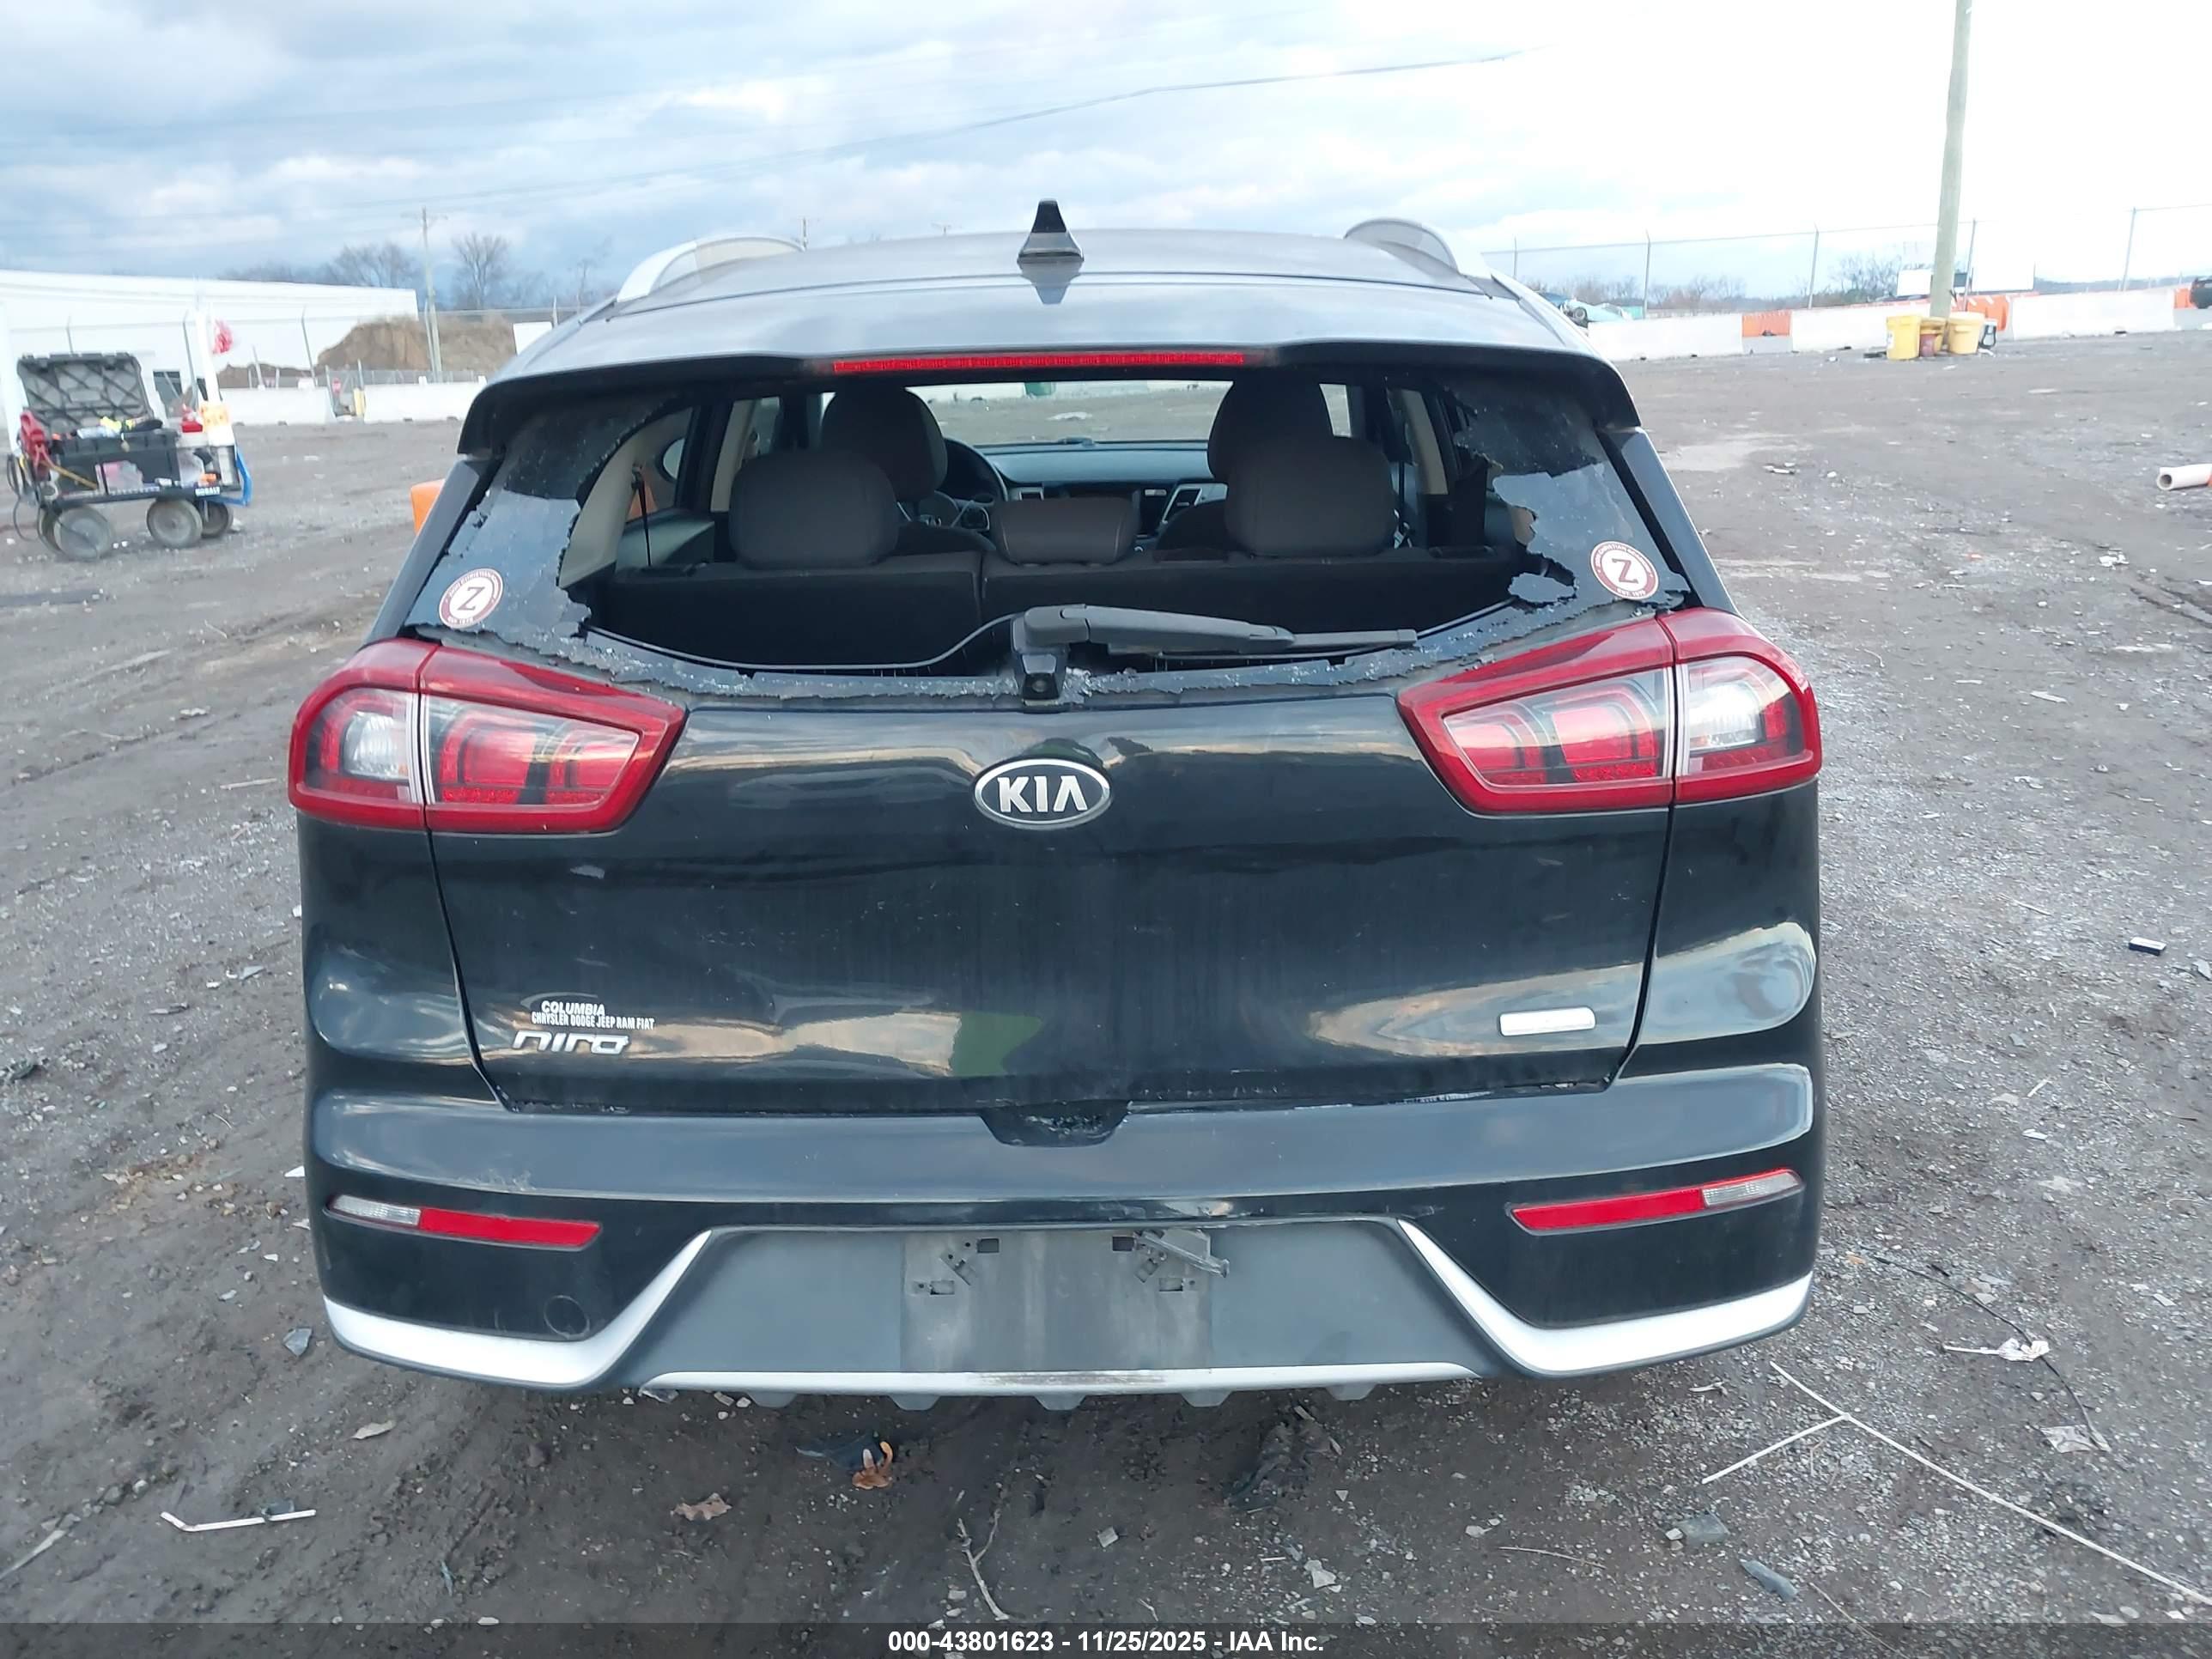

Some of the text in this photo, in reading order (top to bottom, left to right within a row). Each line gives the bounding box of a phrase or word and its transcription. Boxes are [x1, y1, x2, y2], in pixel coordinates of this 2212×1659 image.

[1612, 557, 1639, 584] Z
[457, 586, 485, 611] Z
[997, 775, 1088, 813] KIA
[541, 1000, 605, 1016] COLUMBIA
[531, 1012, 655, 1030] CHRYSLER DODGE JEEP RAM FIAT
